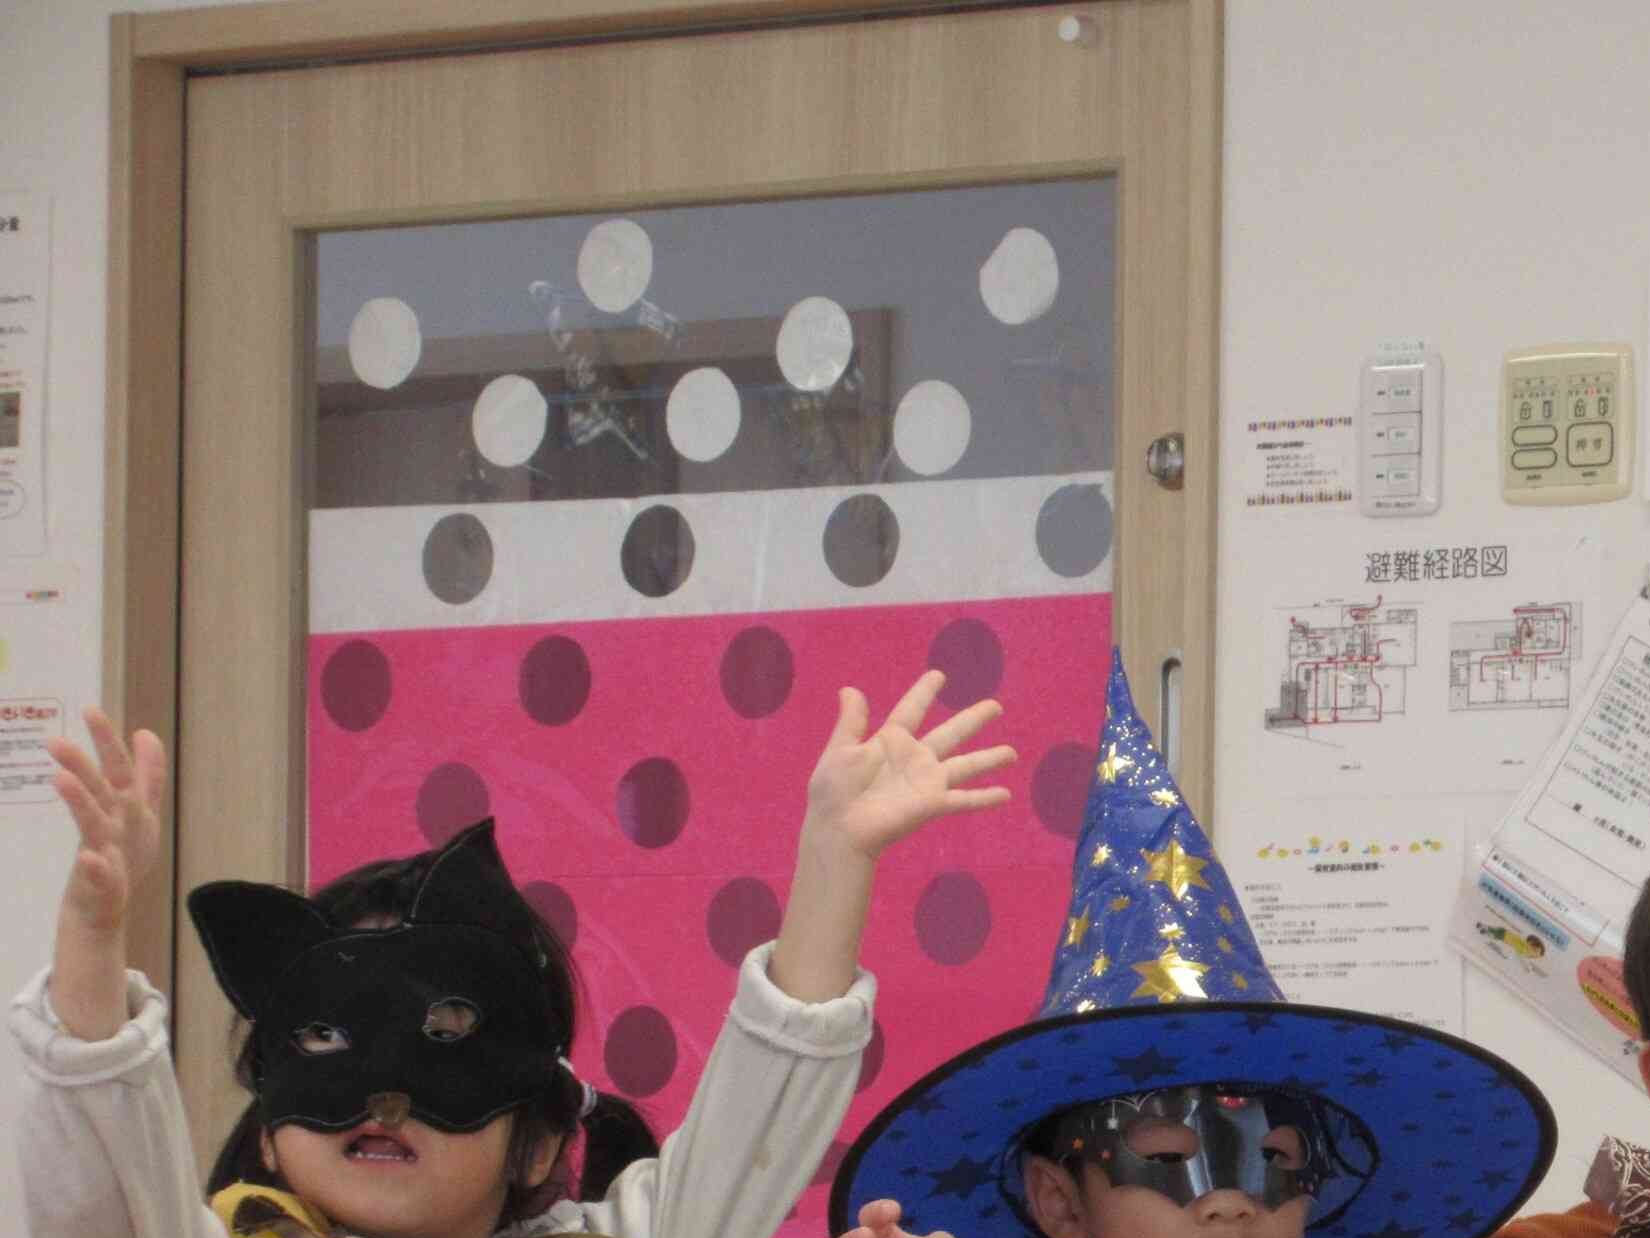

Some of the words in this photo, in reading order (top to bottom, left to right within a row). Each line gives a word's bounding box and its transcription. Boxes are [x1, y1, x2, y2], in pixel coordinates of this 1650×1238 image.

[1364, 545, 1508, 583] 避難経路図
